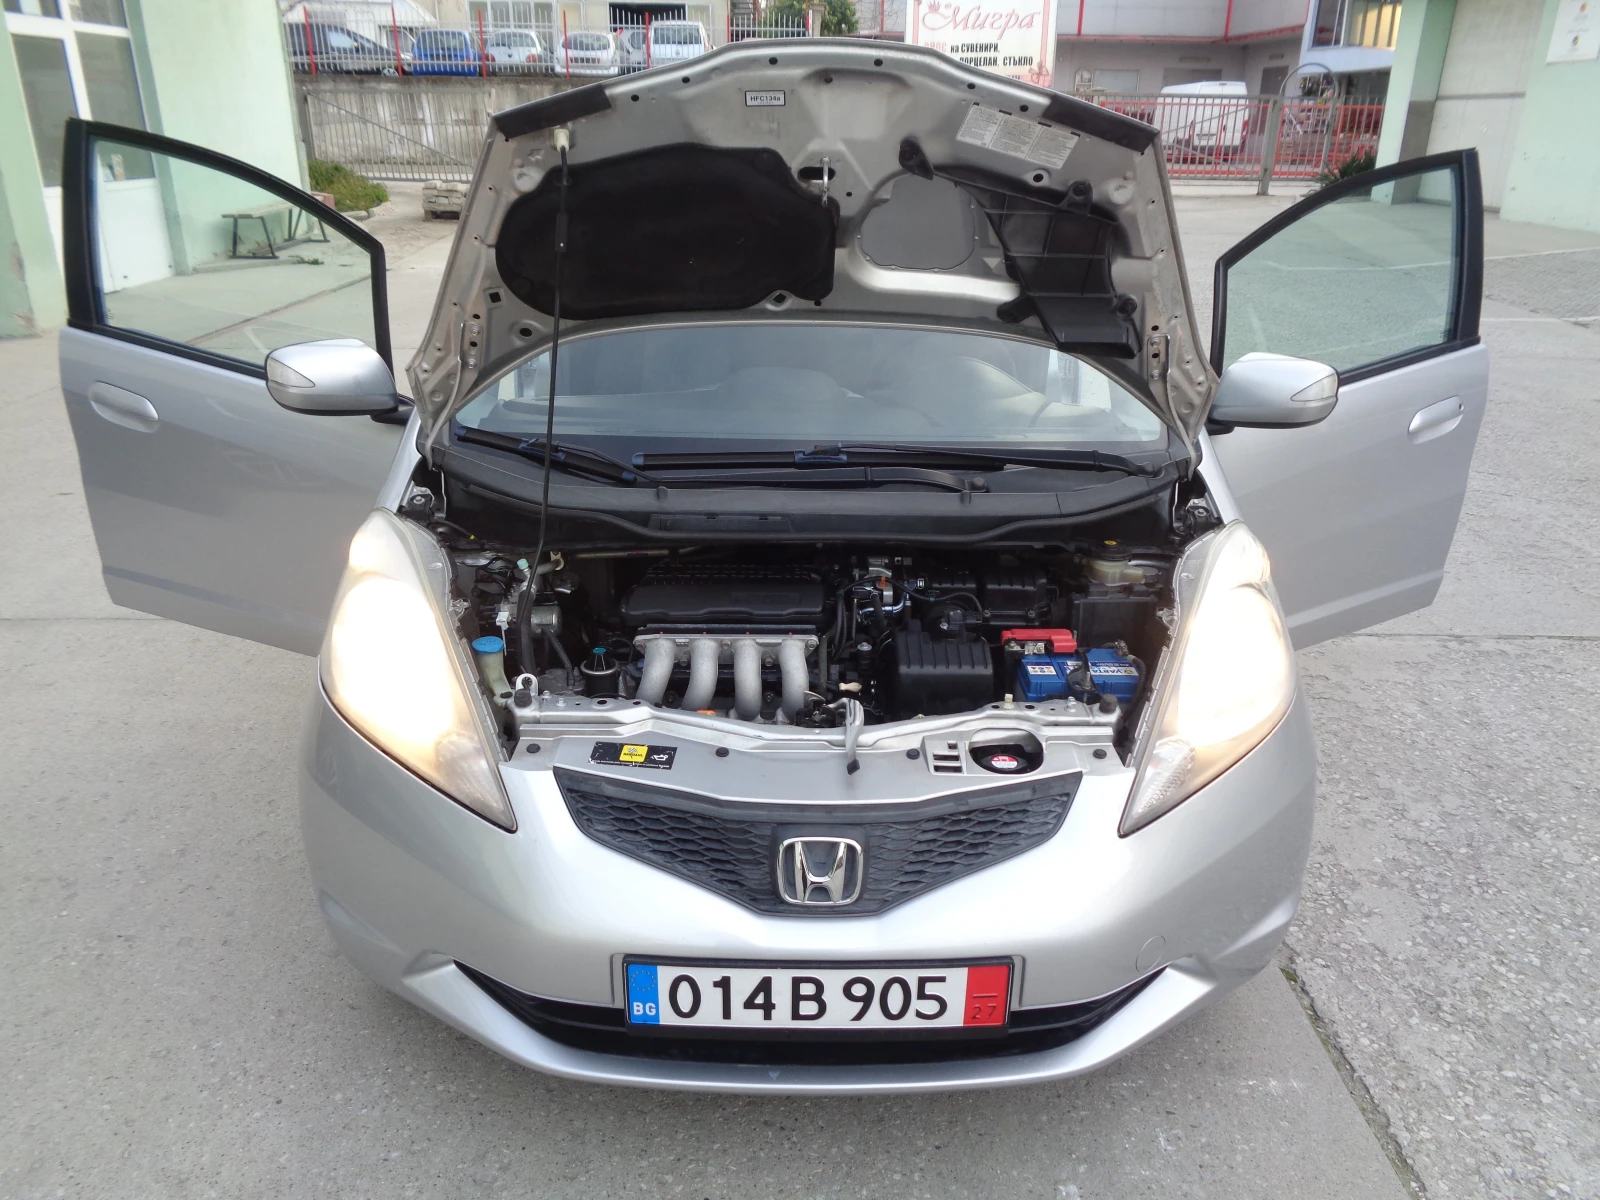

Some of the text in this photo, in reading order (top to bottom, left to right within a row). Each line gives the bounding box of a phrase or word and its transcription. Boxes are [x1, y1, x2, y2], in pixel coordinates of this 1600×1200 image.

[922, 5, 1040, 40] Мигра
[950, 45, 959, 53] на
[1002, 56, 1033, 66] СТЪКЛО
[668, 973, 948, 1021] 014 B 905
[632, 1001, 657, 1017] BG
[971, 1003, 997, 1020] 27
